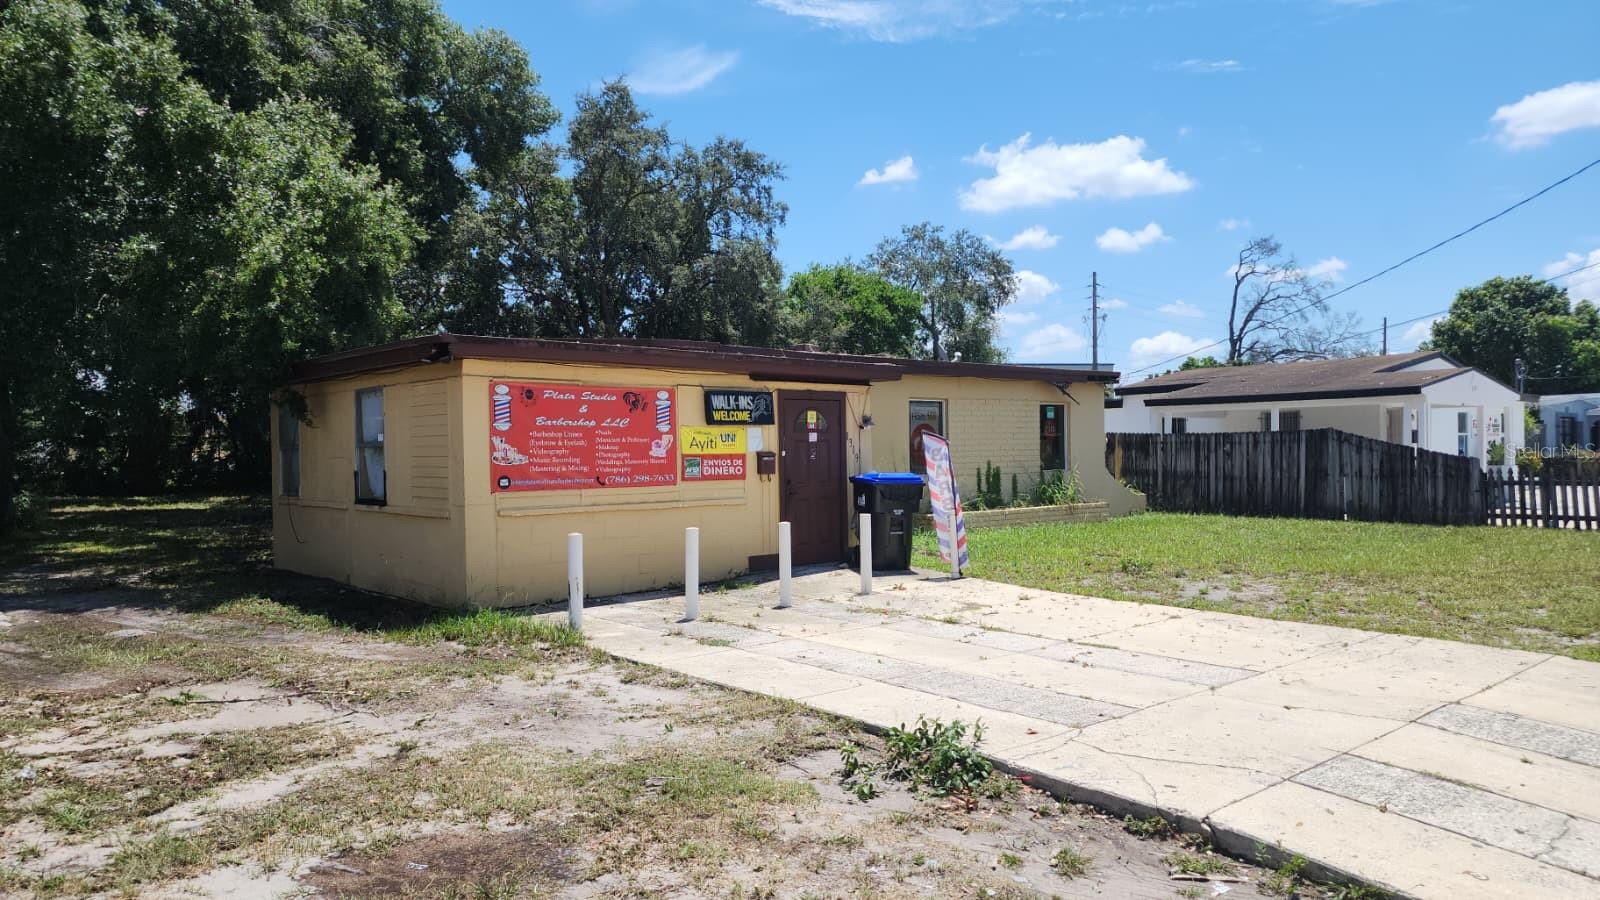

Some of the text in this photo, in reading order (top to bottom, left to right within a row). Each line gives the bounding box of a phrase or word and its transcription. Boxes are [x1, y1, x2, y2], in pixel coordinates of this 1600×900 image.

[543, 390, 617, 401] Plata Studio
[711, 394, 753, 410] WALK-INS
[578, 404, 589, 413] &
[712, 410, 752, 421] WELCOME
[536, 416, 630, 428] Barbershop LLC
[720, 433, 736, 443] UNI
[689, 436, 717, 452] Ayiti
[732, 458, 744, 466] DE
[703, 466, 743, 475] DINERO
[605, 474, 631, 485] (786)
[632, 474, 675, 483] 298-7633
